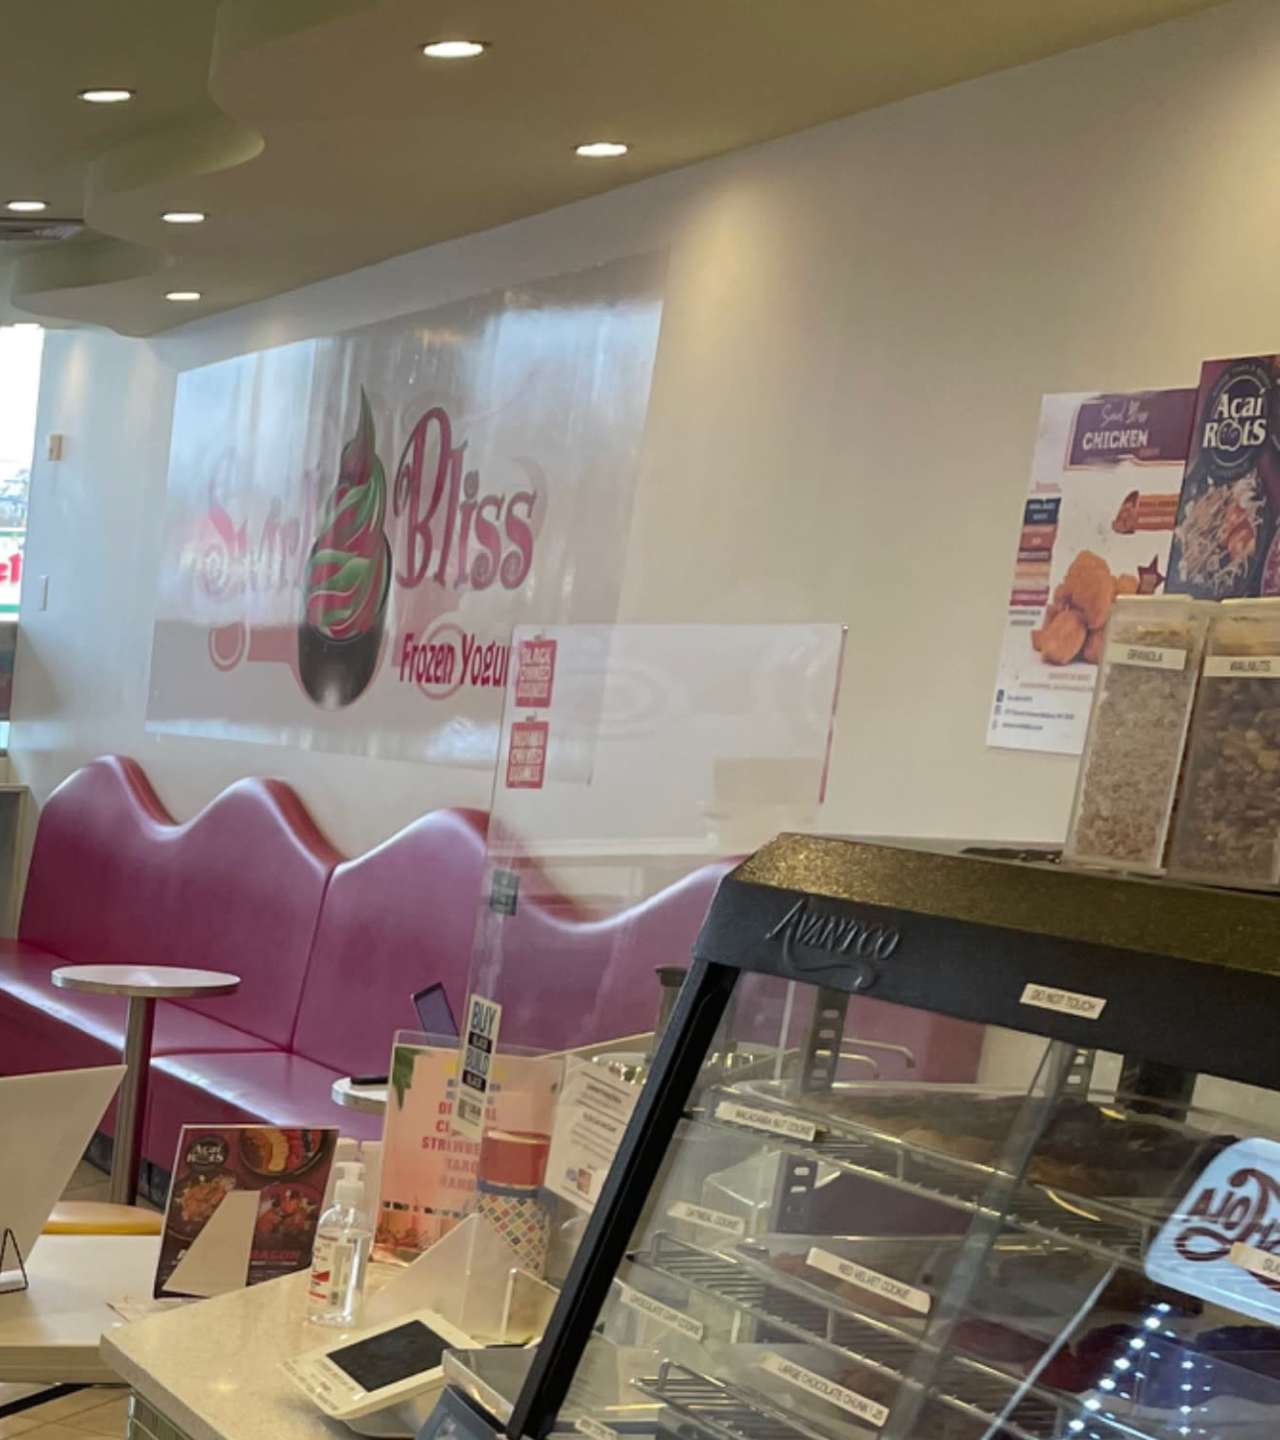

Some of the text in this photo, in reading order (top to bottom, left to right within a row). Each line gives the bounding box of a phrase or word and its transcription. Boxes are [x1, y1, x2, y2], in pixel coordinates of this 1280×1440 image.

[1082, 429, 1149, 450] CHICKEN
[394, 406, 537, 591] Bliss
[399, 633, 456, 686] Frozen
[471, 1001, 497, 1036] BUY
